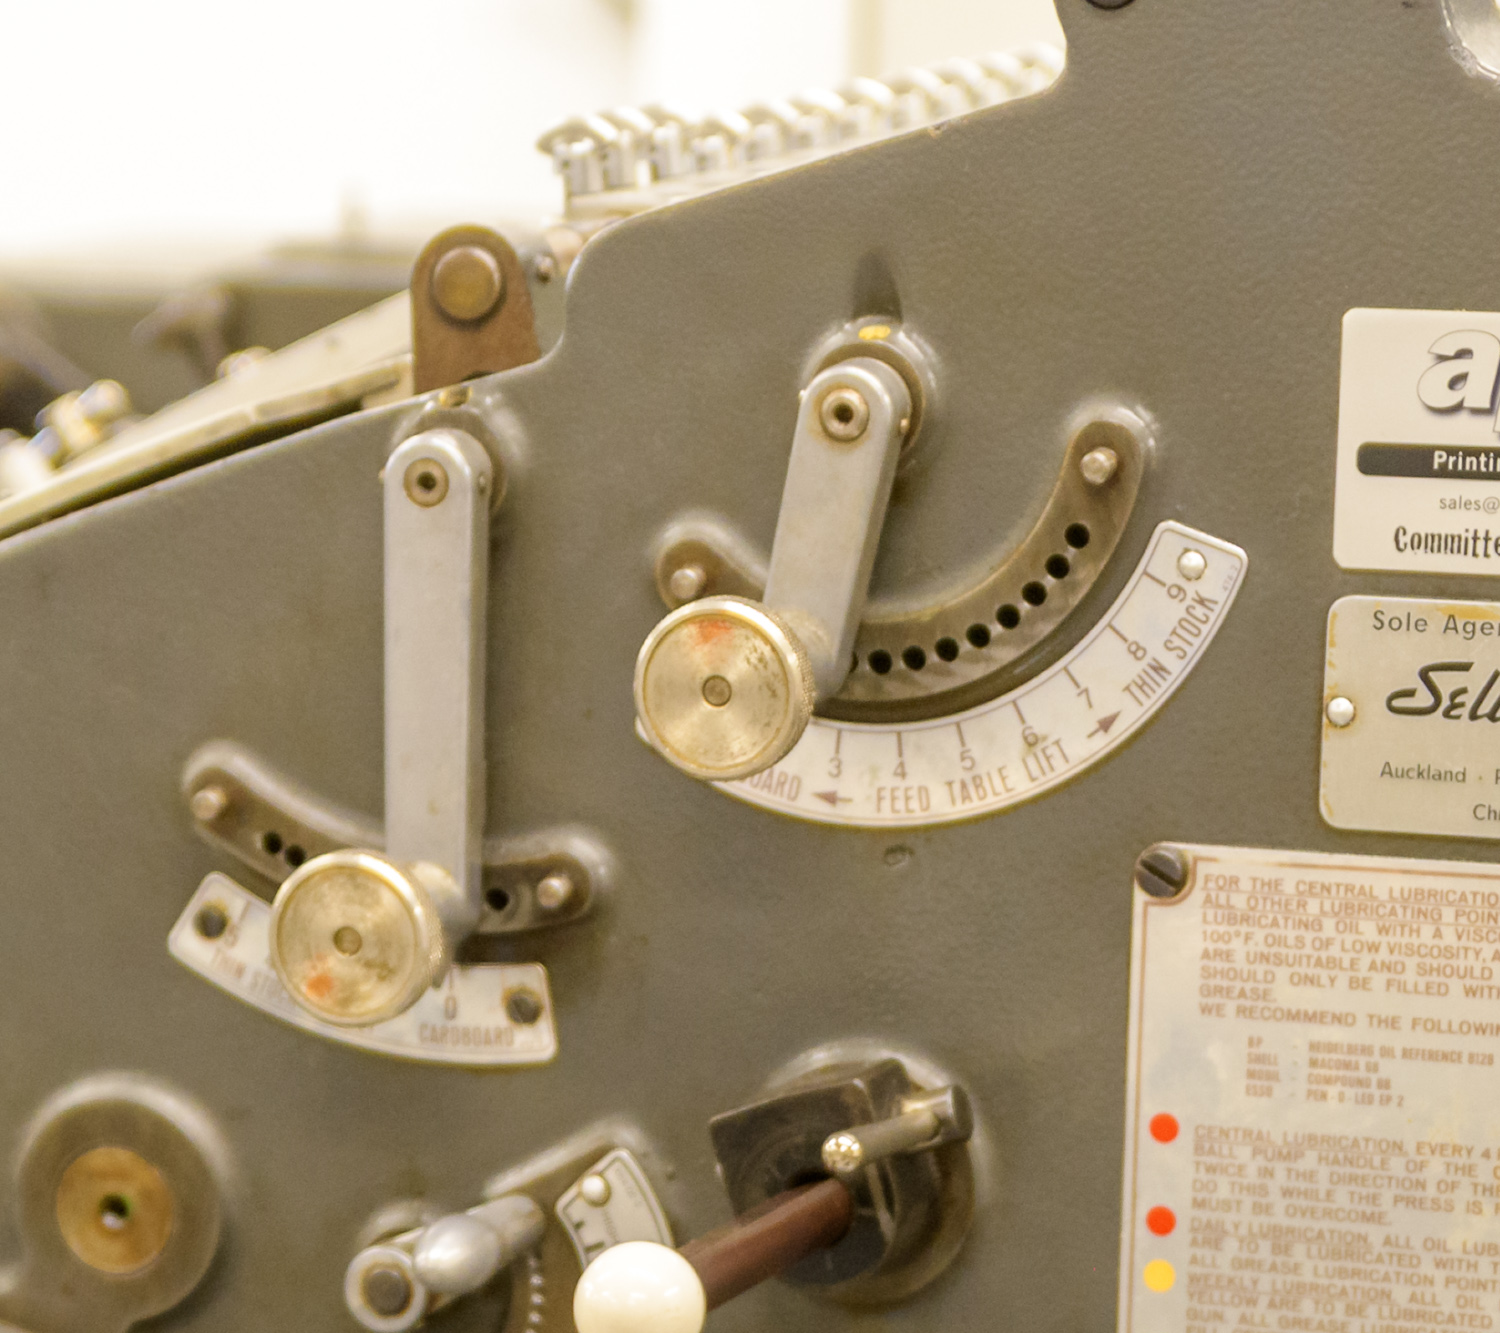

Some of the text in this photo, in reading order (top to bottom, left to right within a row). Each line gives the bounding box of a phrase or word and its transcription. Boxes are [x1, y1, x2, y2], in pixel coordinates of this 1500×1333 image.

[1166, 584, 1187, 603] 9
[1372, 609, 1428, 633] Sole
[1122, 590, 1219, 707] THIN STOCK
[1127, 640, 1147, 661] 8
[1077, 688, 1094, 710] 7
[1021, 726, 1040, 747] 6
[828, 757, 843, 778] 3
[892, 759, 908, 780] 4
[960, 749, 979, 772] 5
[876, 738, 1071, 814] FEED TABLE LIFT
[1380, 761, 1467, 784] Auckland
[1203, 873, 1240, 891] FOR
[1249, 876, 1283, 893] THE
[1295, 879, 1378, 899] CENTRAL
[1202, 892, 1235, 909] ALL
[1246, 895, 1308, 913] OTHER
[1319, 900, 1442, 922] LUBRICATING
[1202, 911, 1323, 933] LUBRICATING
[1334, 919, 1364, 935] OIL
[1375, 922, 1421, 939] WITH
[1431, 926, 1444, 941] A
[1263, 933, 1306, 951] OILS
[1311, 936, 1335, 953] OF
[1340, 938, 1381, 956] LOW
[1200, 948, 1235, 965] ARE
[1245, 951, 1360, 973] UNSUITABLE
[1367, 958, 1406, 976] AND
[1415, 962, 1493, 981] SHOULD
[1199, 965, 1275, 986] SHOULD
[1288, 971, 1337, 990] ONLY
[1348, 975, 1373, 993] BE
[1385, 978, 1449, 998] FILLED
[1198, 1002, 1226, 1019] WE
[1235, 1004, 1356, 1027] RECOMMEND
[1366, 1013, 1402, 1030] THE
